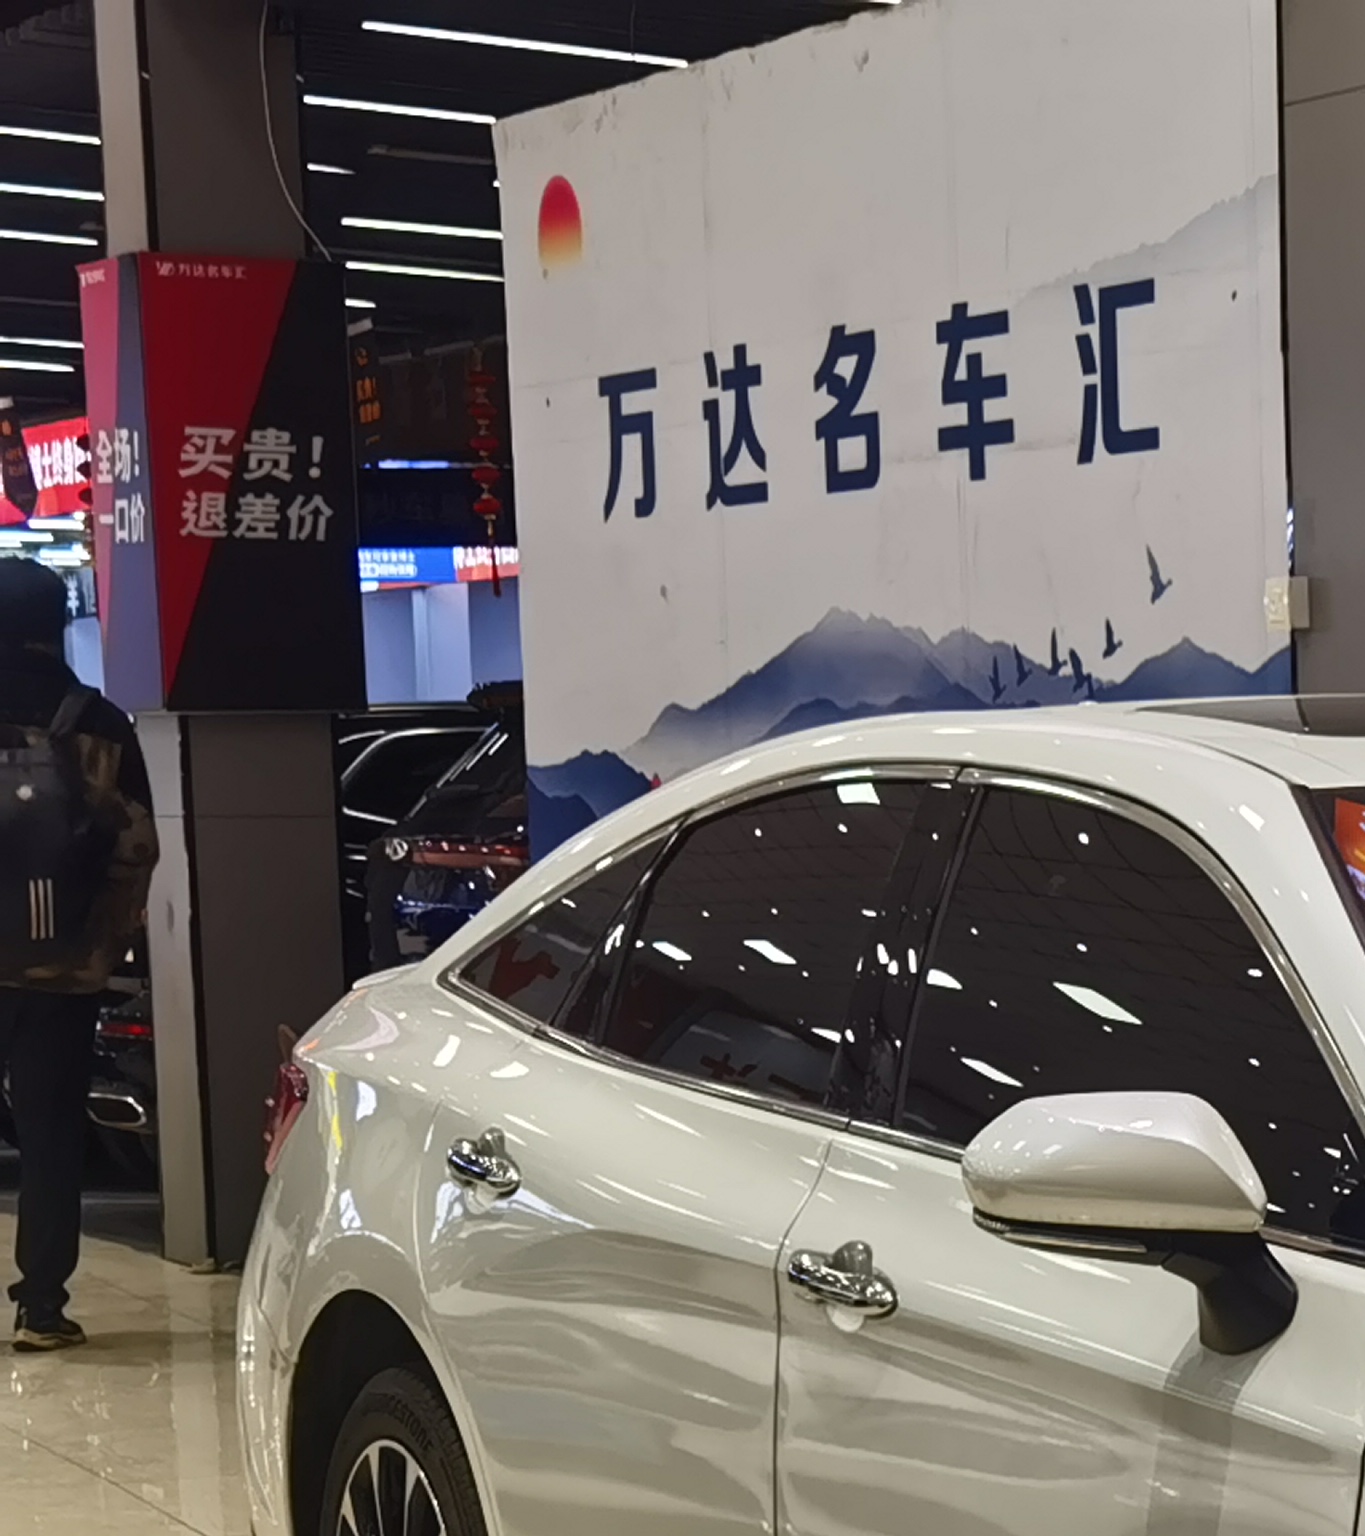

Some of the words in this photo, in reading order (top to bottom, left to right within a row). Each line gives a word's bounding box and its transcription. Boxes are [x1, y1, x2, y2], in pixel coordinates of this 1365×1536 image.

[597, 278, 1161, 524] 万达名车汇
[179, 490, 335, 542] 退差价
